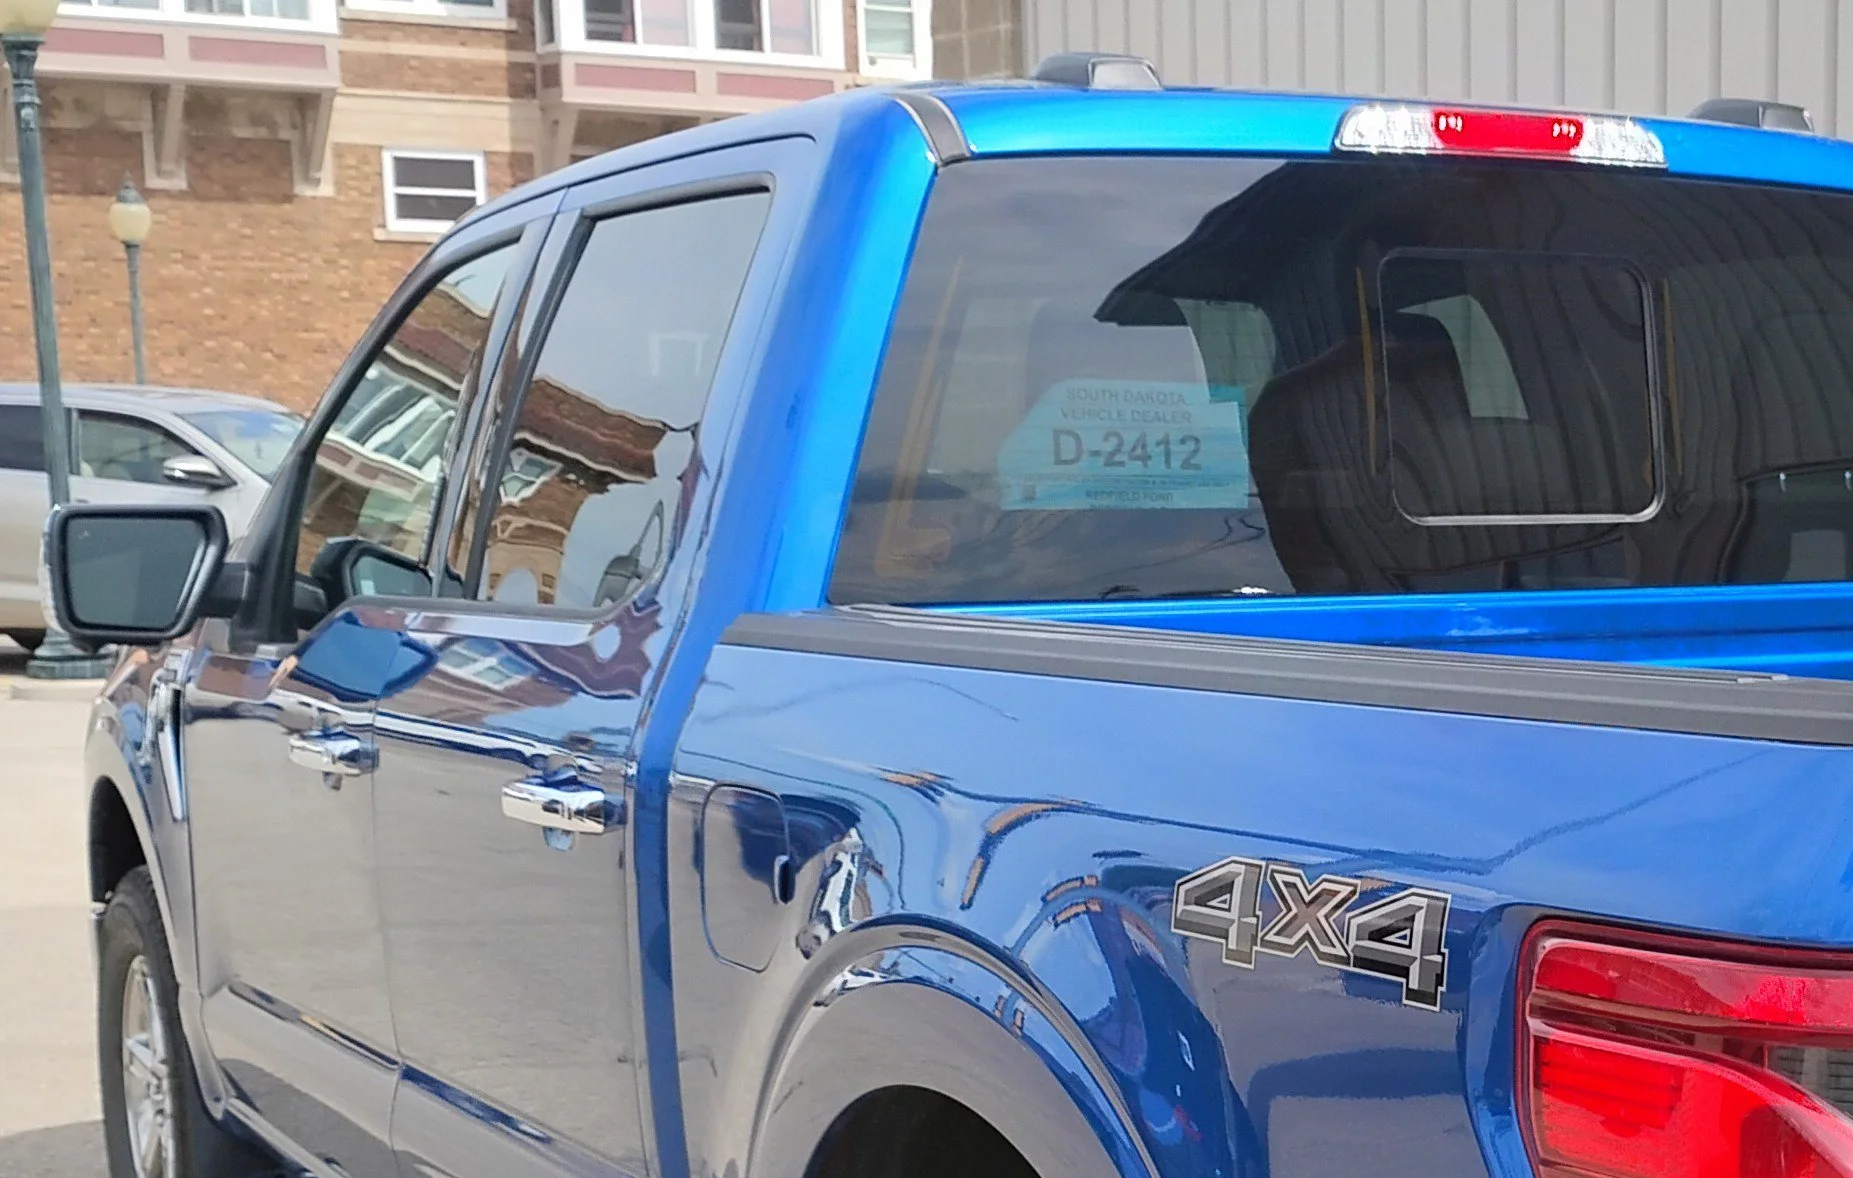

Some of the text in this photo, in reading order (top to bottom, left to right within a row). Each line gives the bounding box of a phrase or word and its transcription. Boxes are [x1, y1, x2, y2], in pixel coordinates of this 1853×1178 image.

[1066, 387, 1187, 405] SOUTH DAKOTA
[1060, 406, 1192, 424] VEHICLE DEALER
[1052, 428, 1203, 471] D-2412
